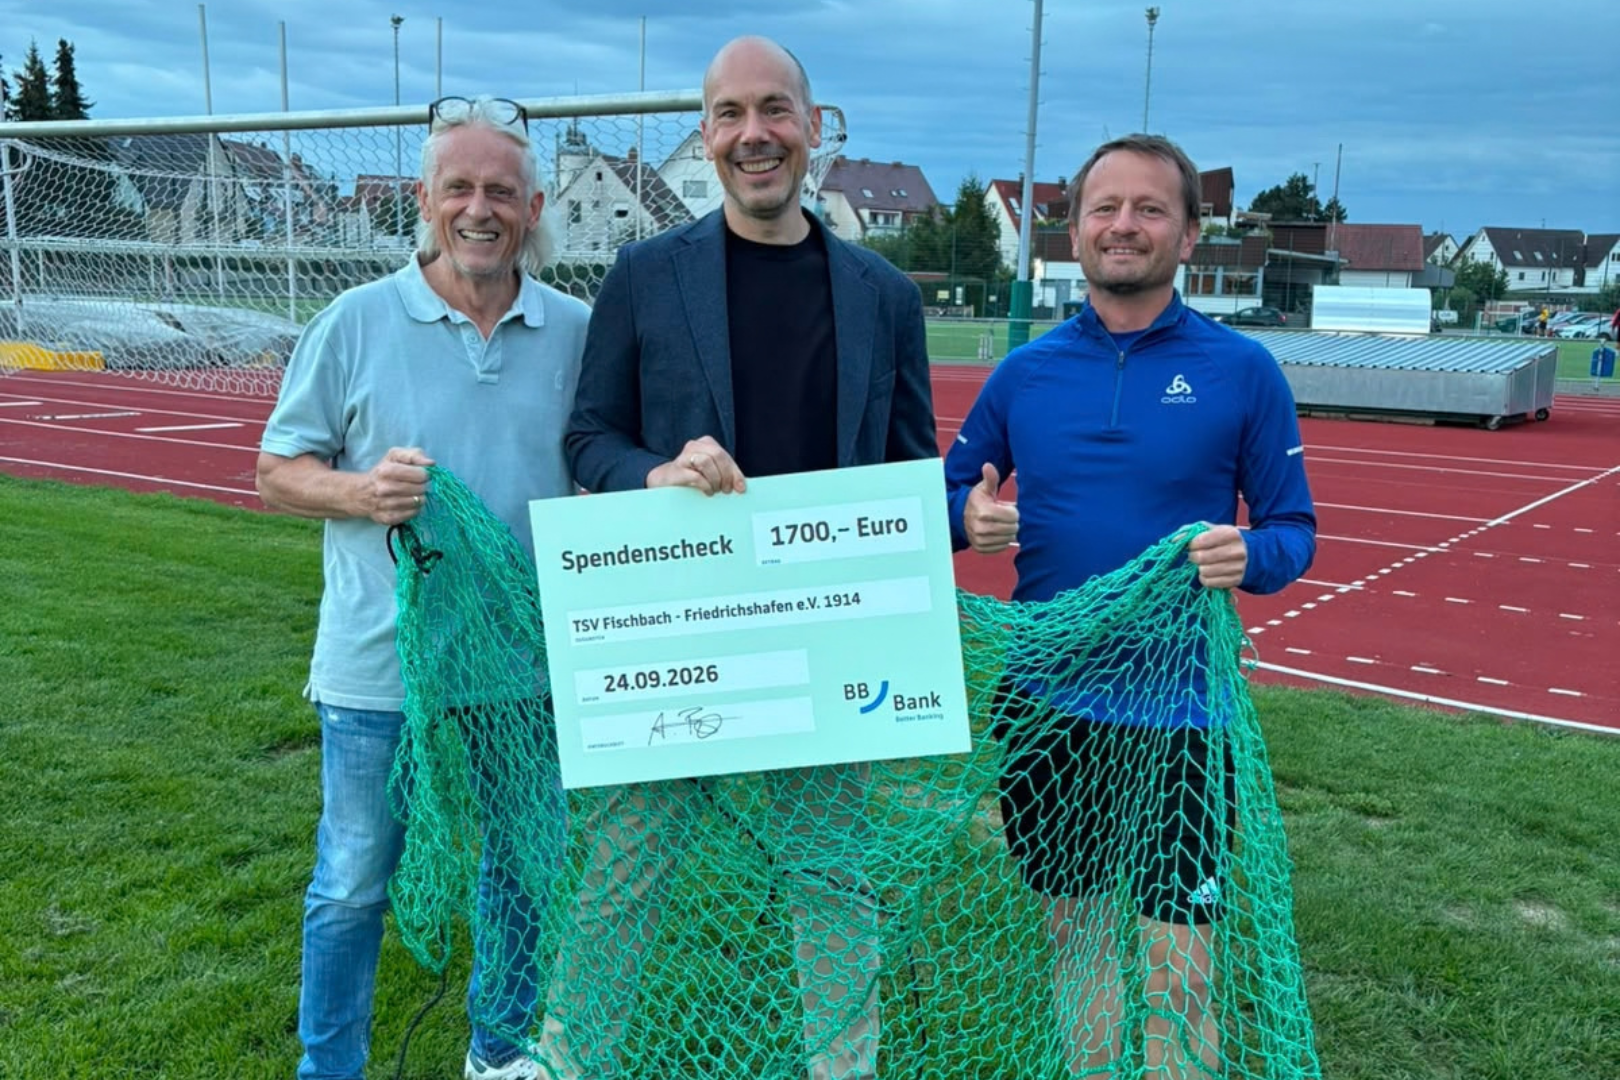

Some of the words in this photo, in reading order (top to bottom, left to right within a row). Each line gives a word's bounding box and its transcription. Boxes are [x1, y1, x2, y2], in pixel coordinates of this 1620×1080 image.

[1160, 394, 1197, 404] odlo
[856, 516, 908, 538] Euro
[561, 534, 734, 574] Spendenscheck
[572, 617, 600, 633] TSV
[602, 611, 672, 630] Fischbach
[684, 600, 794, 622] Friedrichshafen
[796, 597, 821, 611] e.V.
[824, 592, 861, 608] 1914
[603, 664, 719, 693] 24.09.2026
[843, 682, 870, 701] BB
[893, 690, 942, 712] Bank
[917, 713, 945, 722] Banking
